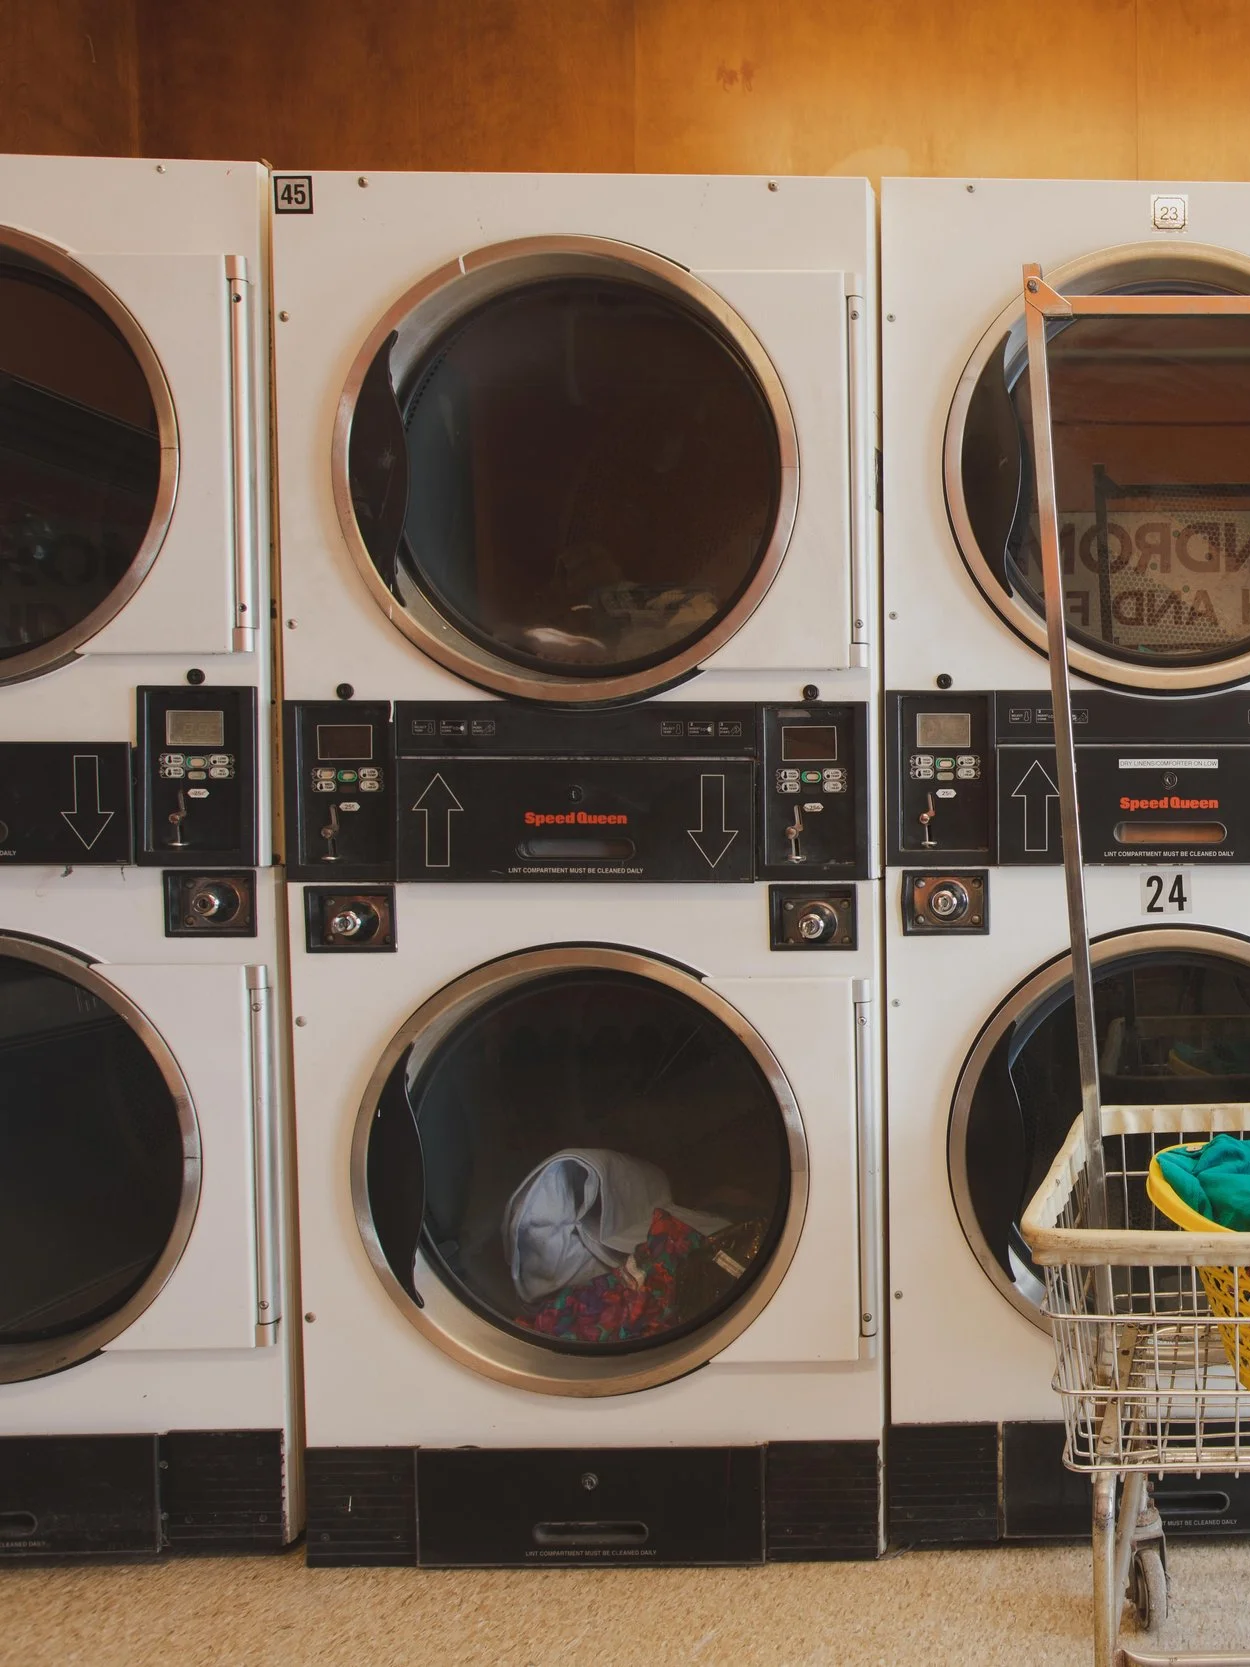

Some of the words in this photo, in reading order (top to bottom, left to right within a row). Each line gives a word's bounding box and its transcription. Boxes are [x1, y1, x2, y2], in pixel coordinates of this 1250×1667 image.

[281, 184, 306, 205] 45
[1160, 206, 1179, 220] 23
[1119, 797, 1169, 811] Speed
[1169, 796, 1219, 809] Queen
[524, 812, 576, 826] Speed
[577, 811, 628, 824] Queen
[1146, 874, 1188, 913] 24
